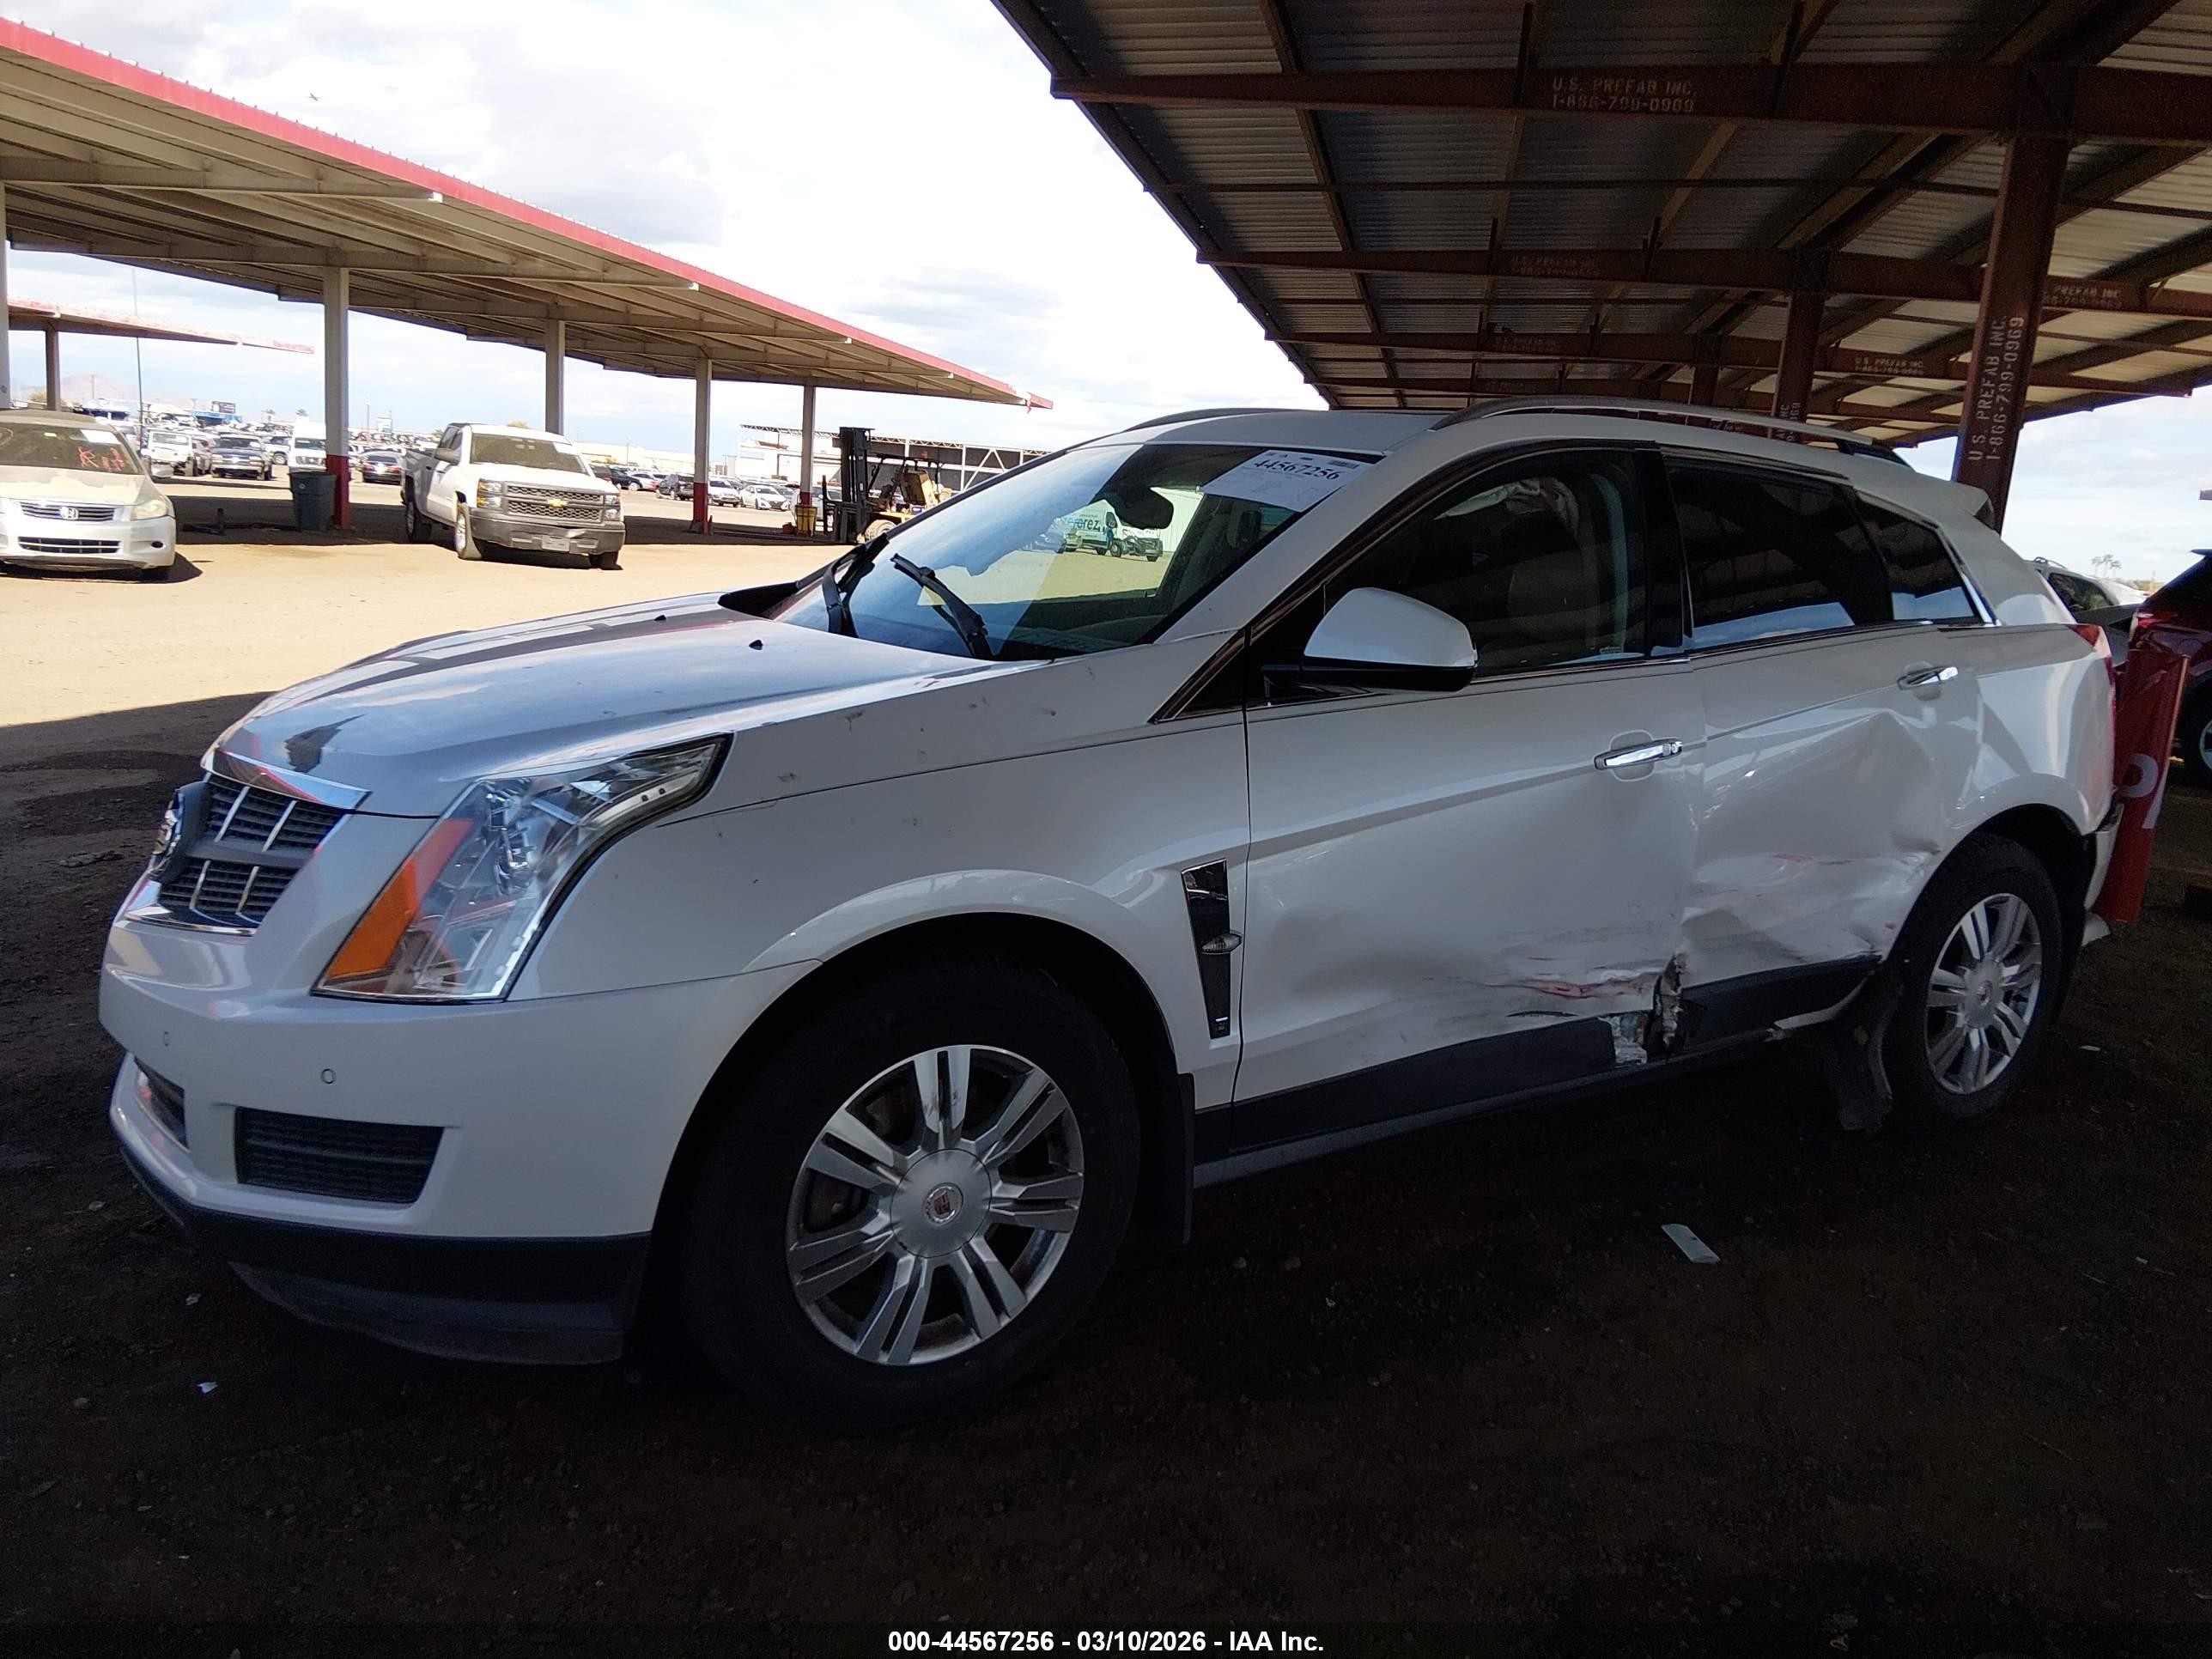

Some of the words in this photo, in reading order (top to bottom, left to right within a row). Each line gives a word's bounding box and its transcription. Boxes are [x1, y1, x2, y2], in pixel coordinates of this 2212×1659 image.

[1595, 78, 1660, 96] PREFAB
[1976, 356, 2001, 421] PREFAB
[1985, 317, 2026, 460] 1-866-799-0969
[1255, 459, 1342, 479] 44567256
